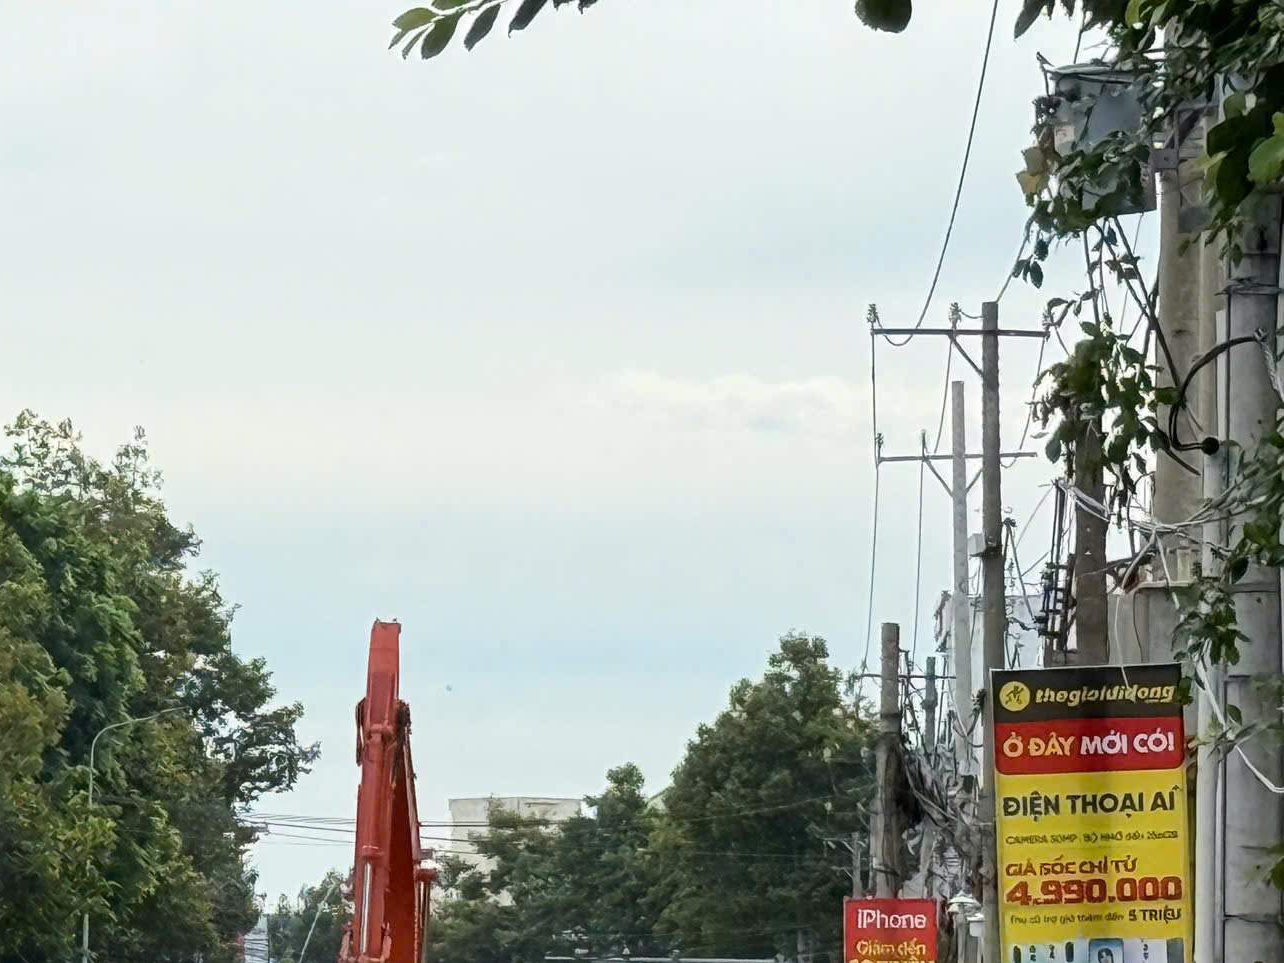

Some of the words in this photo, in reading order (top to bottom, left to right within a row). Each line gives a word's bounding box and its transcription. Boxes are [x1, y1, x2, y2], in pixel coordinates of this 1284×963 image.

[1003, 790, 1060, 823] ĐIỆN
[1066, 791, 1145, 818] THOẠI
[1005, 876, 1183, 906] 4.990.000
